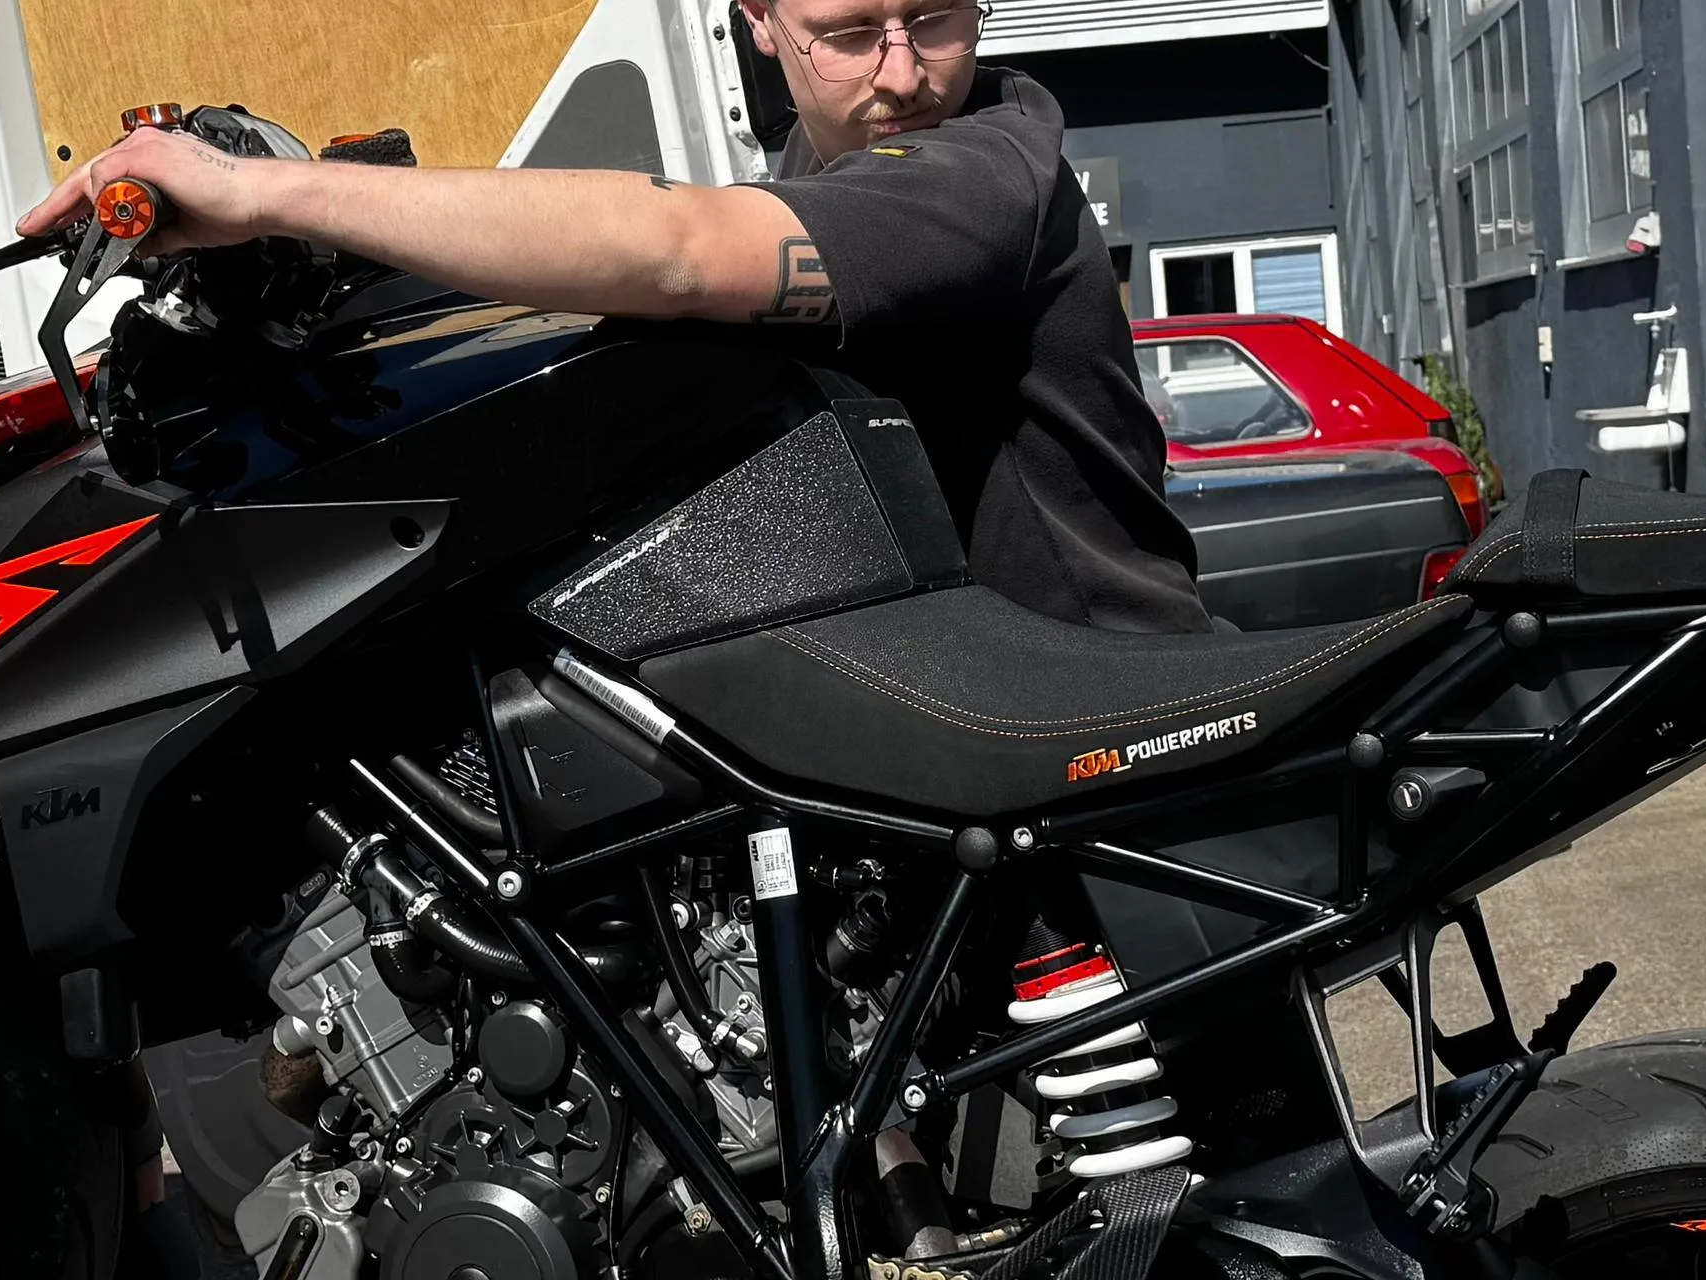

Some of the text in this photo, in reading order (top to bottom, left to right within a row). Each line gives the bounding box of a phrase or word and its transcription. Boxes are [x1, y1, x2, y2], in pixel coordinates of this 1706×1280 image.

[1067, 711, 1258, 782] KTM POWERPARTS
[20, 785, 101, 830] KTM
